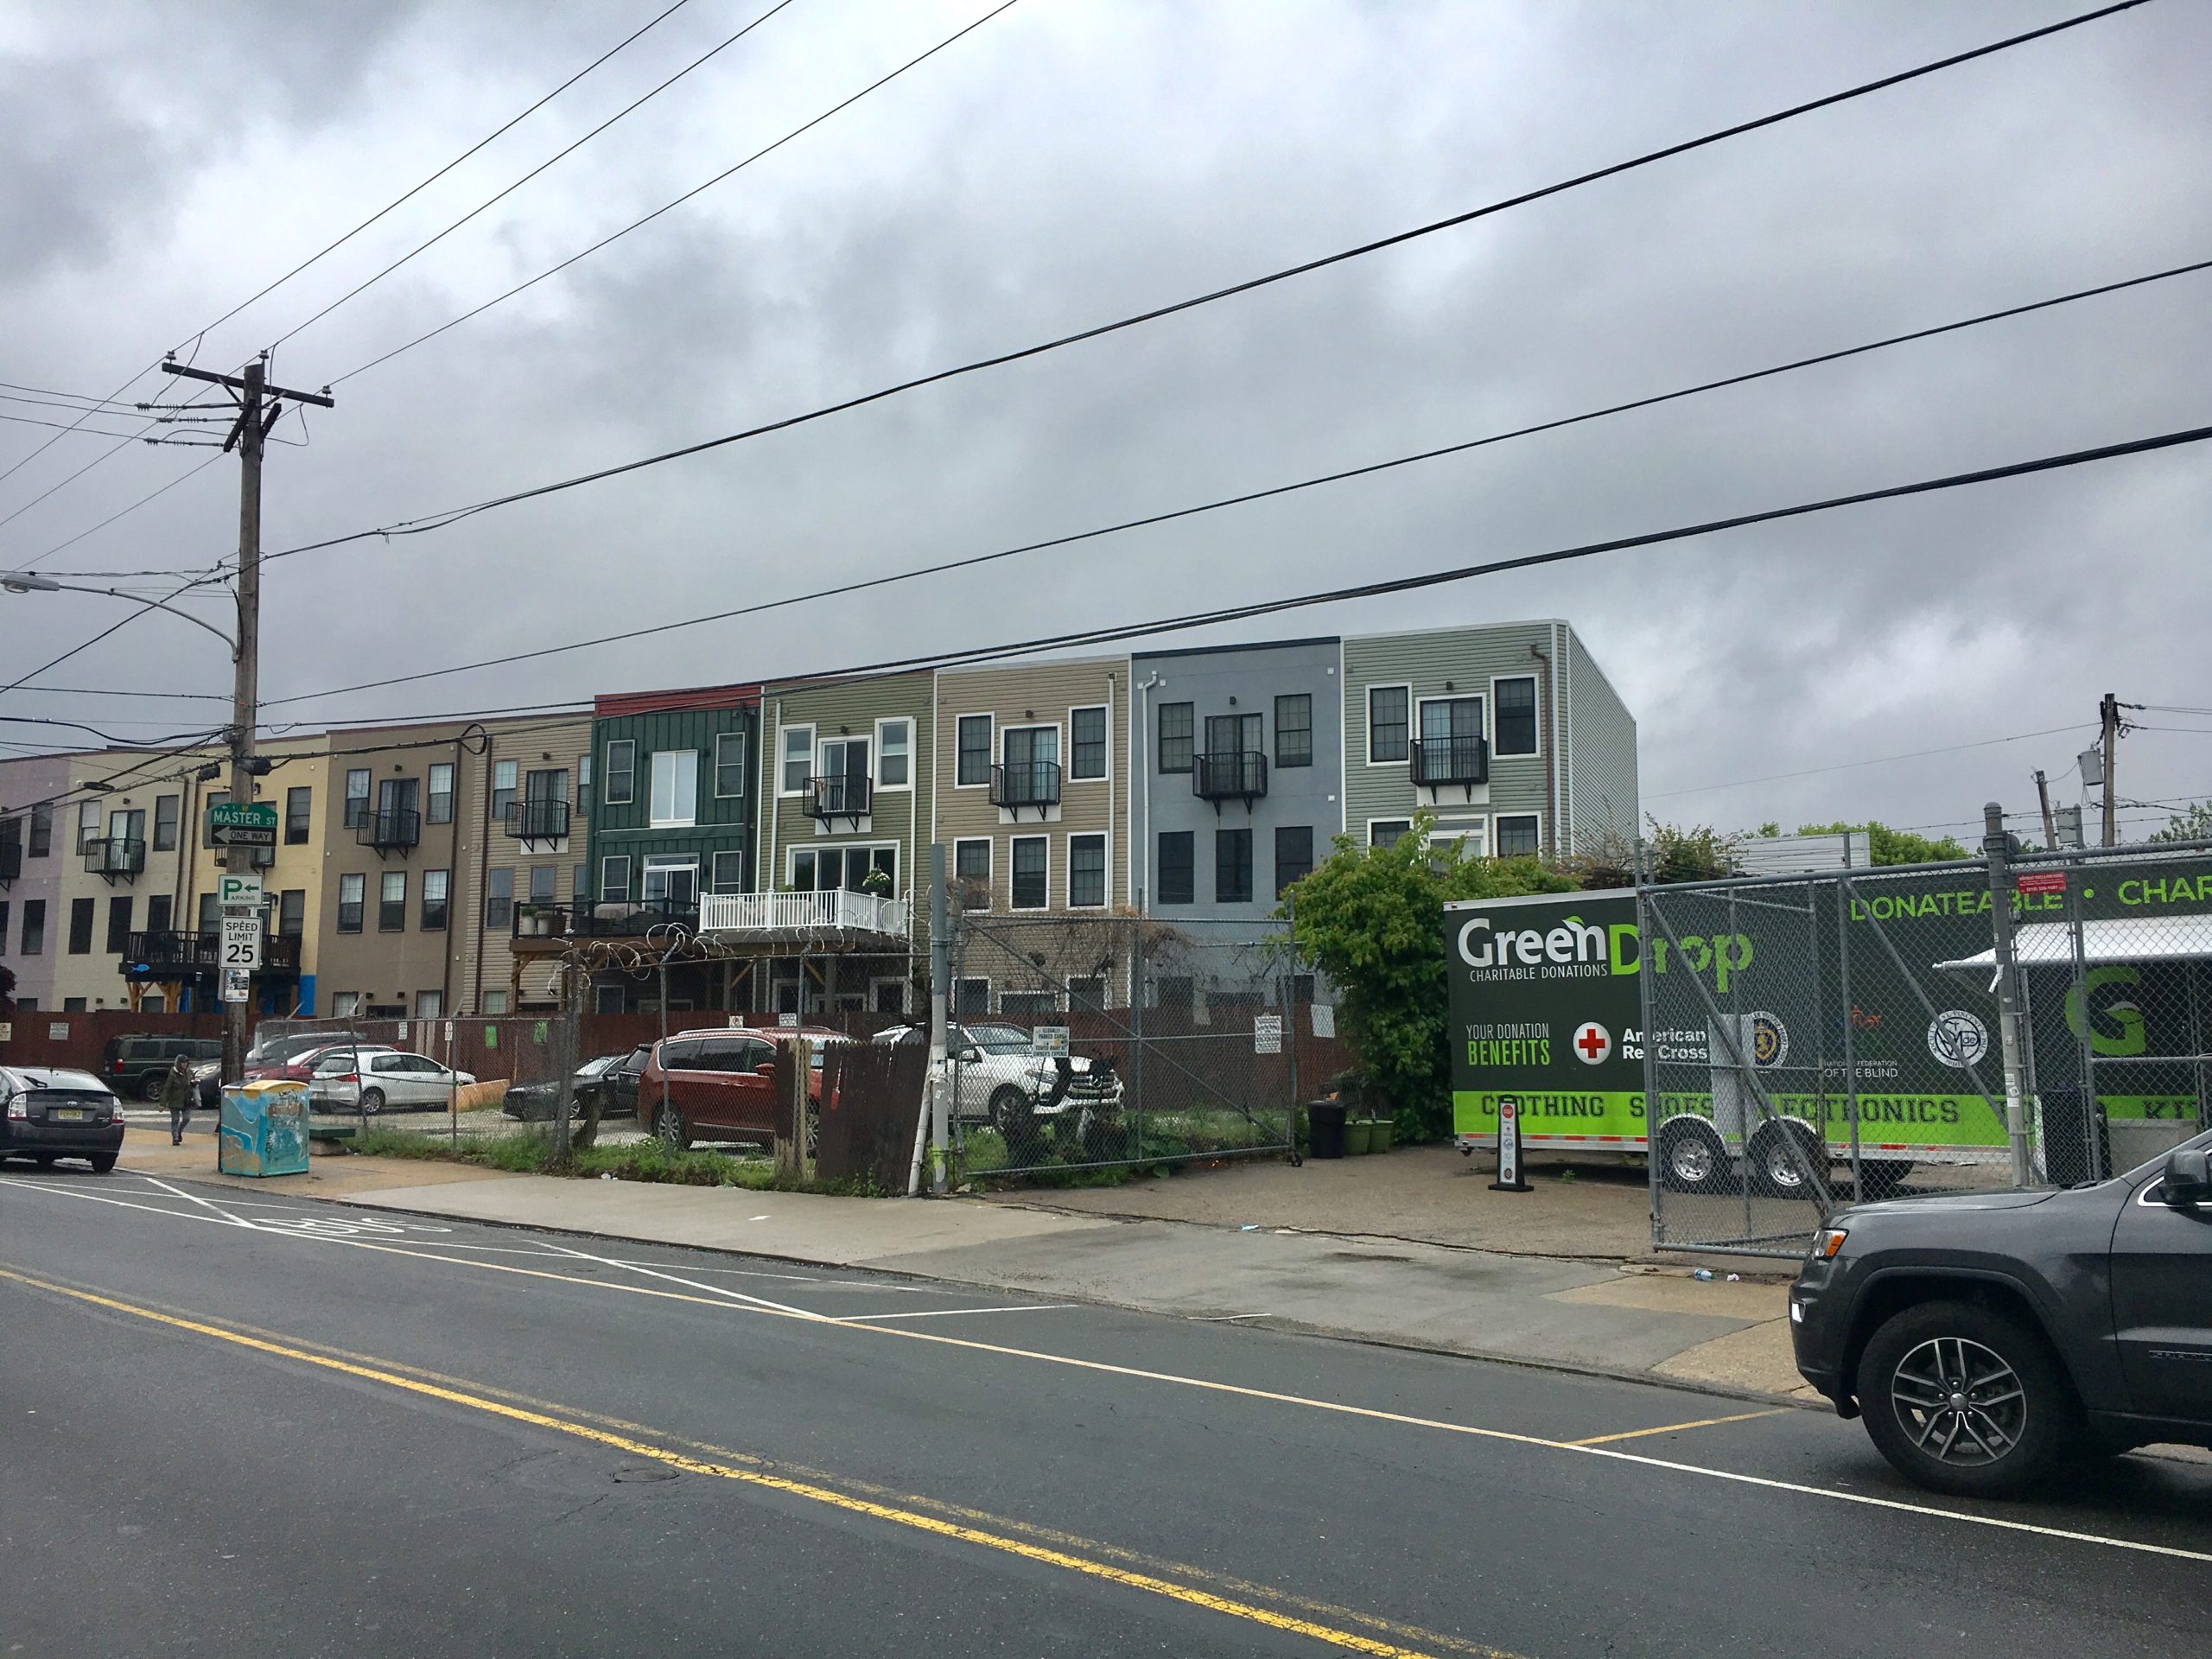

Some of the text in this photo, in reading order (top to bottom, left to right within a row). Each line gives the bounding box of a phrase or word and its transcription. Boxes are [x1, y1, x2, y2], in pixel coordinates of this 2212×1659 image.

[213, 810, 276, 825] MASTER ST
[230, 830, 270, 841] ONE WAY
[226, 921, 257, 931] SPEED
[228, 932, 254, 942] LIMIT
[226, 944, 254, 963] 25
[1470, 963, 1608, 982] CHARITABLE DONATIONS
[1466, 1023, 1549, 1040] YOUR DONATION
[1468, 1039, 1551, 1066] BENEFITS
[1623, 1045, 1708, 1060] Re Cross
[1825, 1068, 1898, 1077] OF TE BLIND
[1482, 1094, 1605, 1118] COTHING
[1630, 1096, 1714, 1120] SOES
